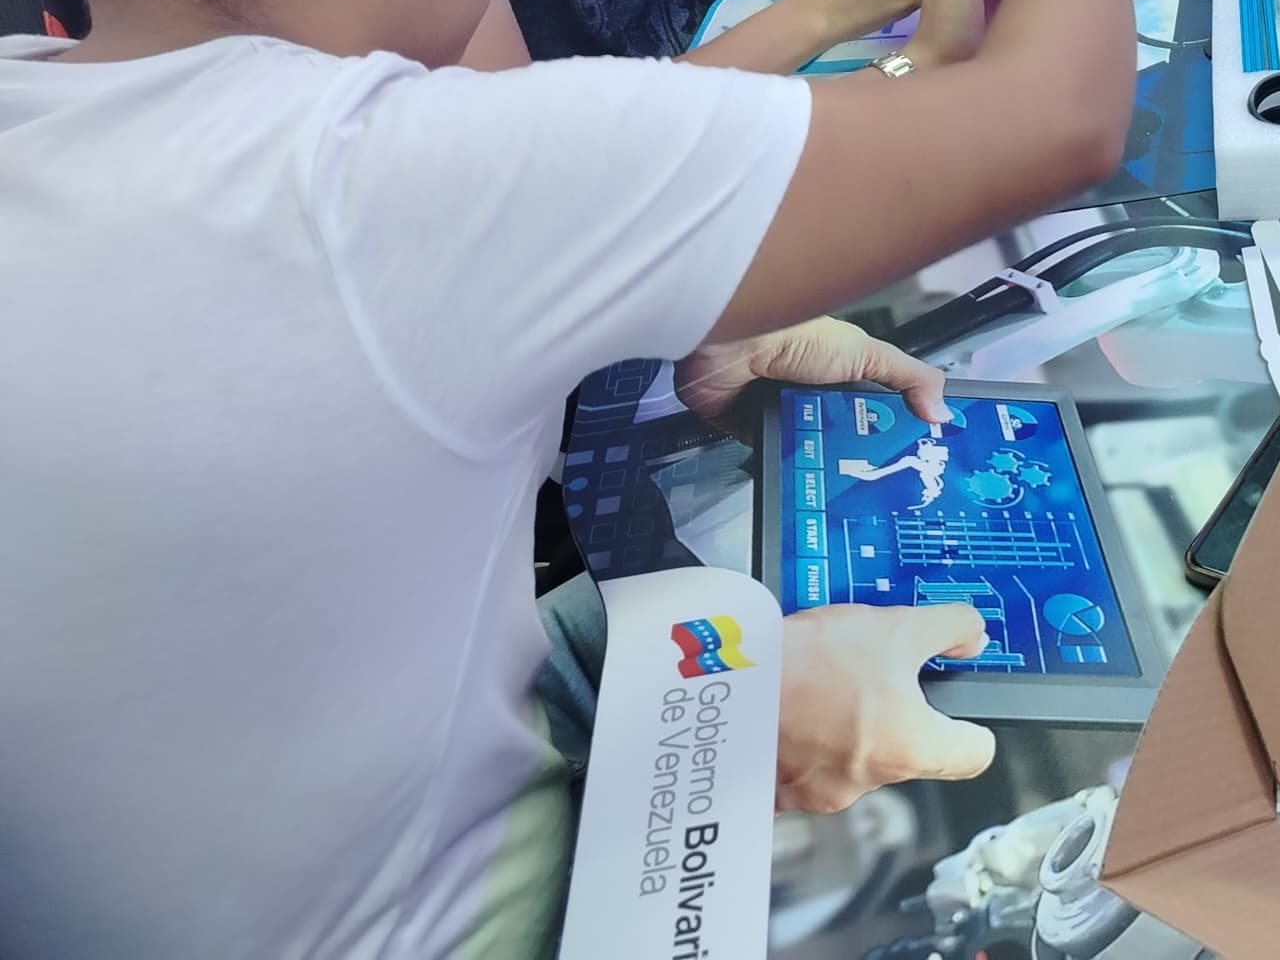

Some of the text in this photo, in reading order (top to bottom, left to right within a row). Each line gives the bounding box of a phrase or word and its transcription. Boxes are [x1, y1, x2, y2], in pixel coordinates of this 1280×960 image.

[803, 403, 814, 422] FILE
[803, 440, 815, 460] EDIT
[804, 472, 817, 509] SELECT
[805, 518, 818, 551] START
[806, 564, 820, 602] FINISH
[638, 687, 695, 898] de Venezuela
[672, 680, 731, 960] Gobierno Bolivari
